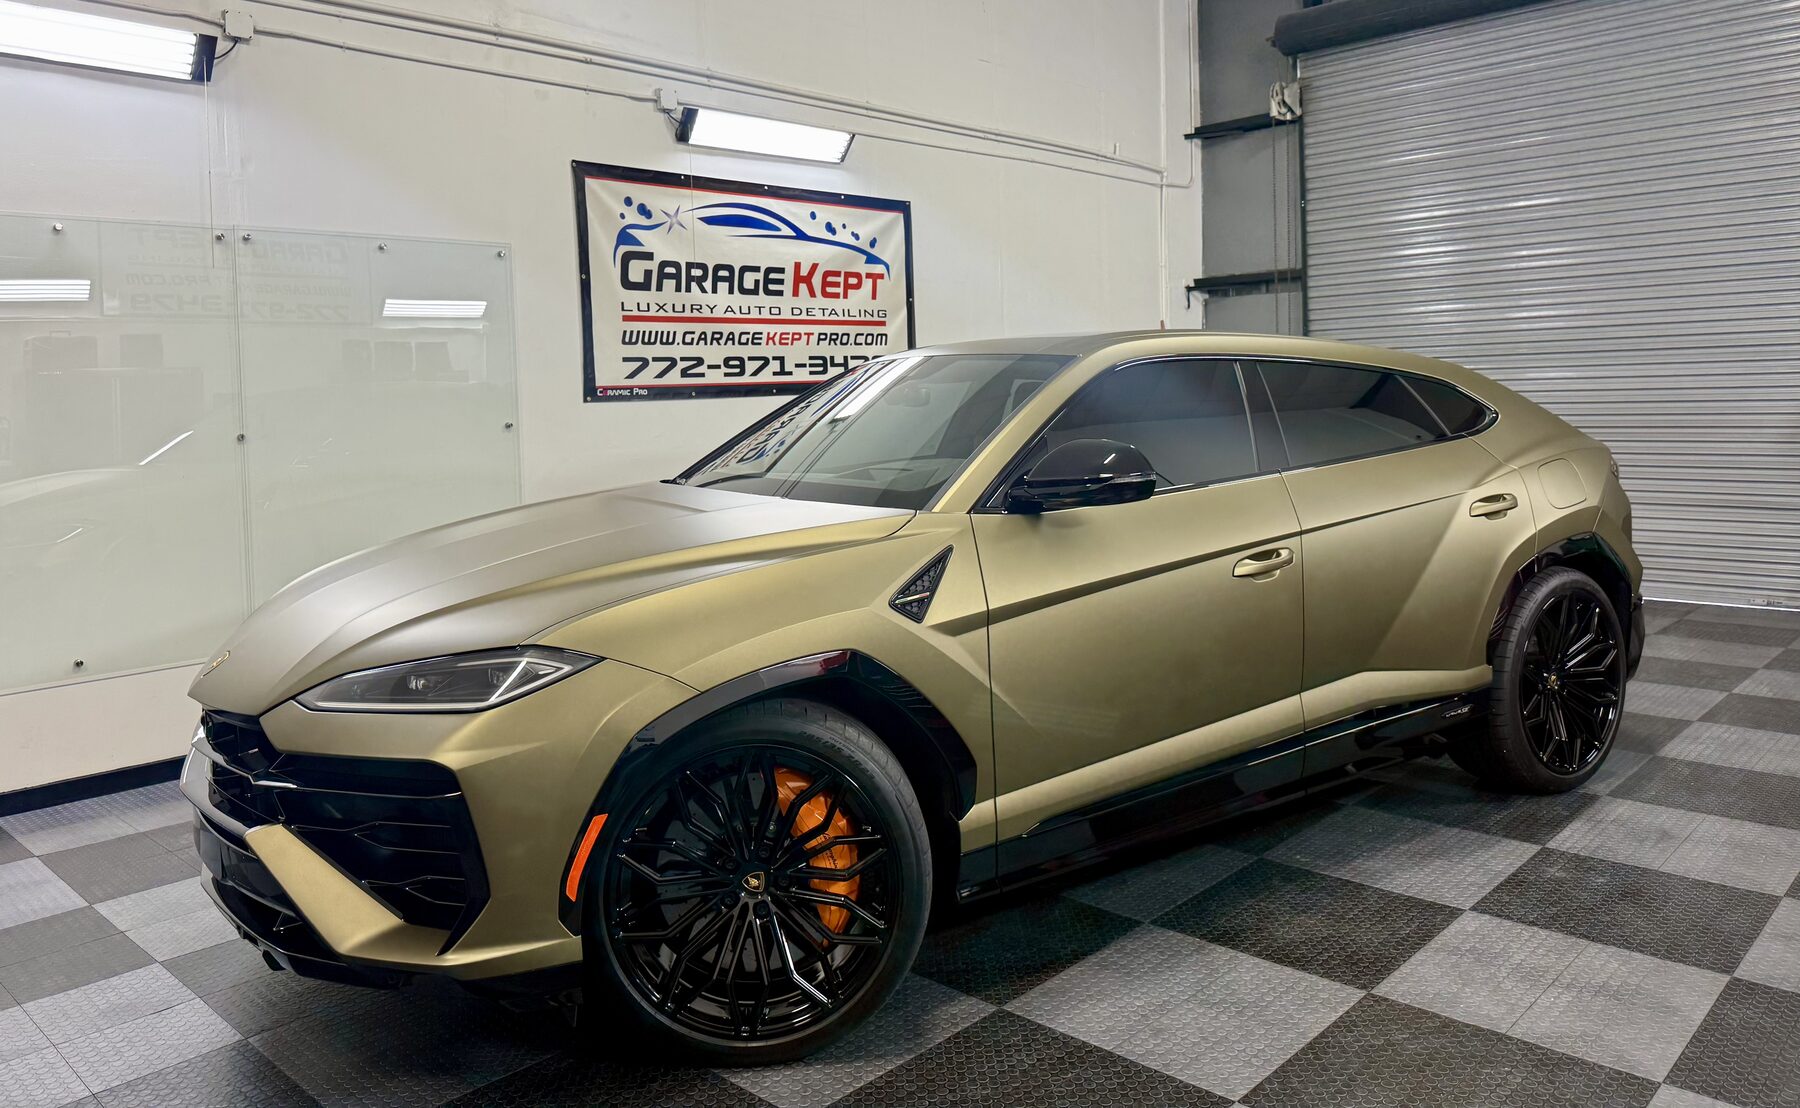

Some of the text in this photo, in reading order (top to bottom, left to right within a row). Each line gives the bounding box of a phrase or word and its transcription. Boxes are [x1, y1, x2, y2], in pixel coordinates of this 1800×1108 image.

[620, 250, 885, 300] GARAGE KEPT
[620, 301, 888, 319] LUXURY AUTO DETAILING
[621, 354, 886, 380] 772-971-34
